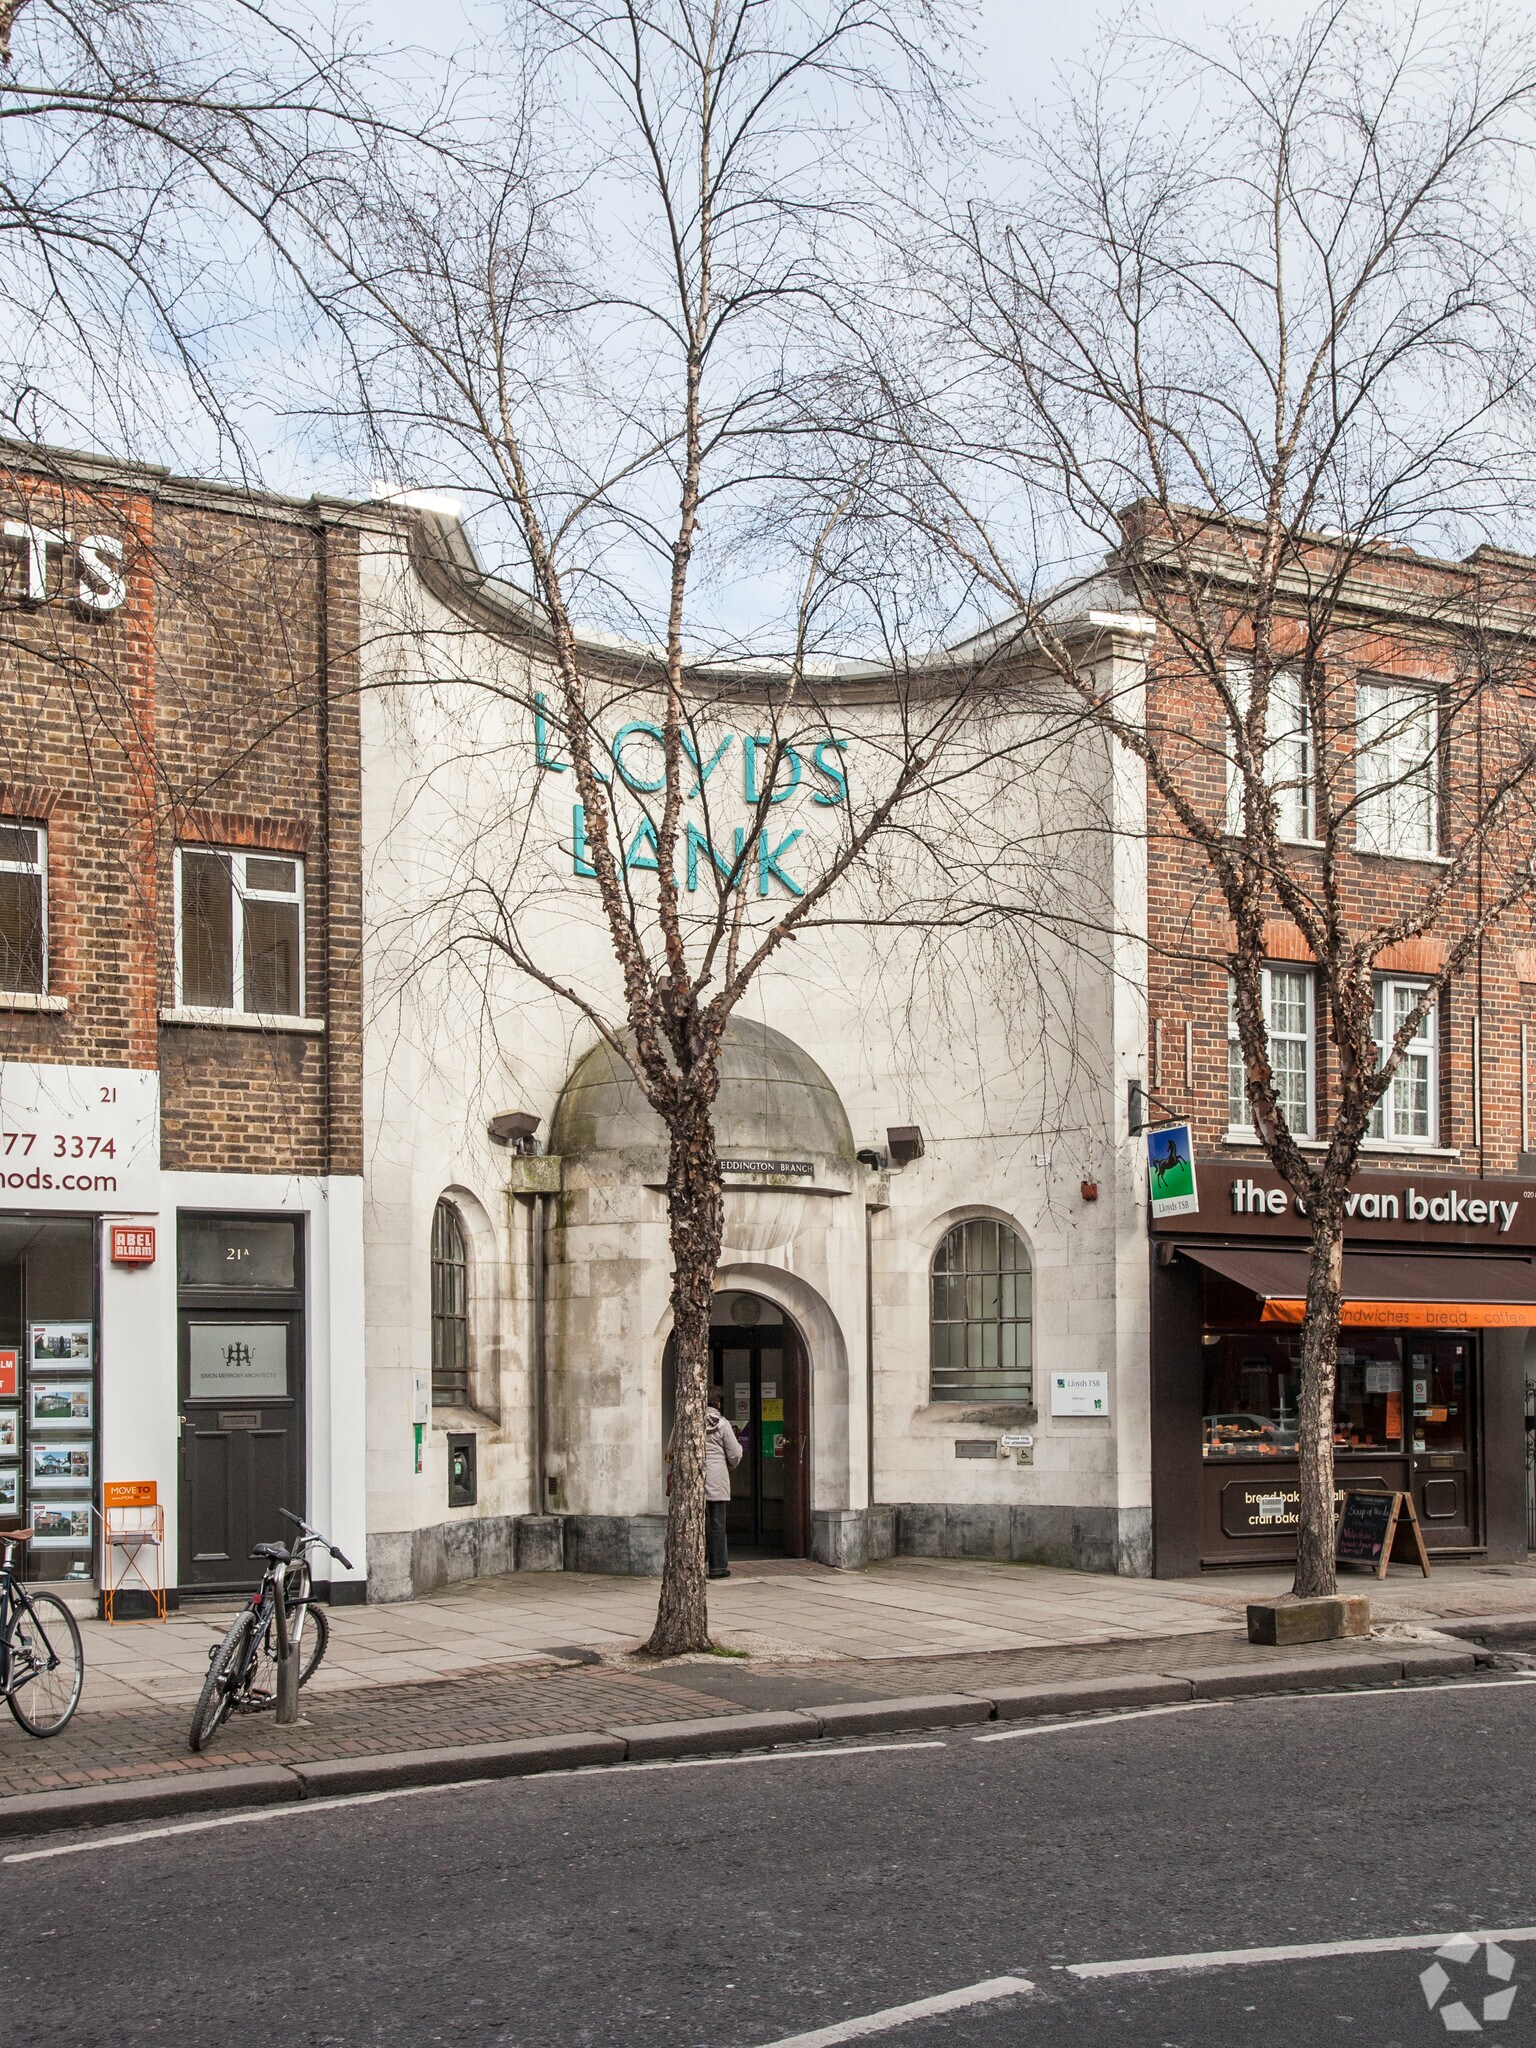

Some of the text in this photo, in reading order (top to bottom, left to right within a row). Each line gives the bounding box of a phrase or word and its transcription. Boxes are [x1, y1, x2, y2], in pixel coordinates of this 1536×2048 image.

[534, 691, 848, 805] LOYDS
[99, 1086, 117, 1103] 21
[53, 1134, 117, 1160] 3374
[720, 1160, 813, 1173] EDDINGTON BRANCH
[1523, 1190, 1535, 1198] 020
[1158, 1200, 1190, 1214] Lloyds TSB
[1232, 1179, 1288, 1214] the
[1406, 1187, 1519, 1232] bakery
[116, 1233, 152, 1247] ABEL
[116, 1245, 152, 1256] ALARM
[1426, 1310, 1468, 1324] bread
[1484, 1311, 1527, 1324] coffee
[1067, 1380, 1101, 1389] Lloyds TSB
